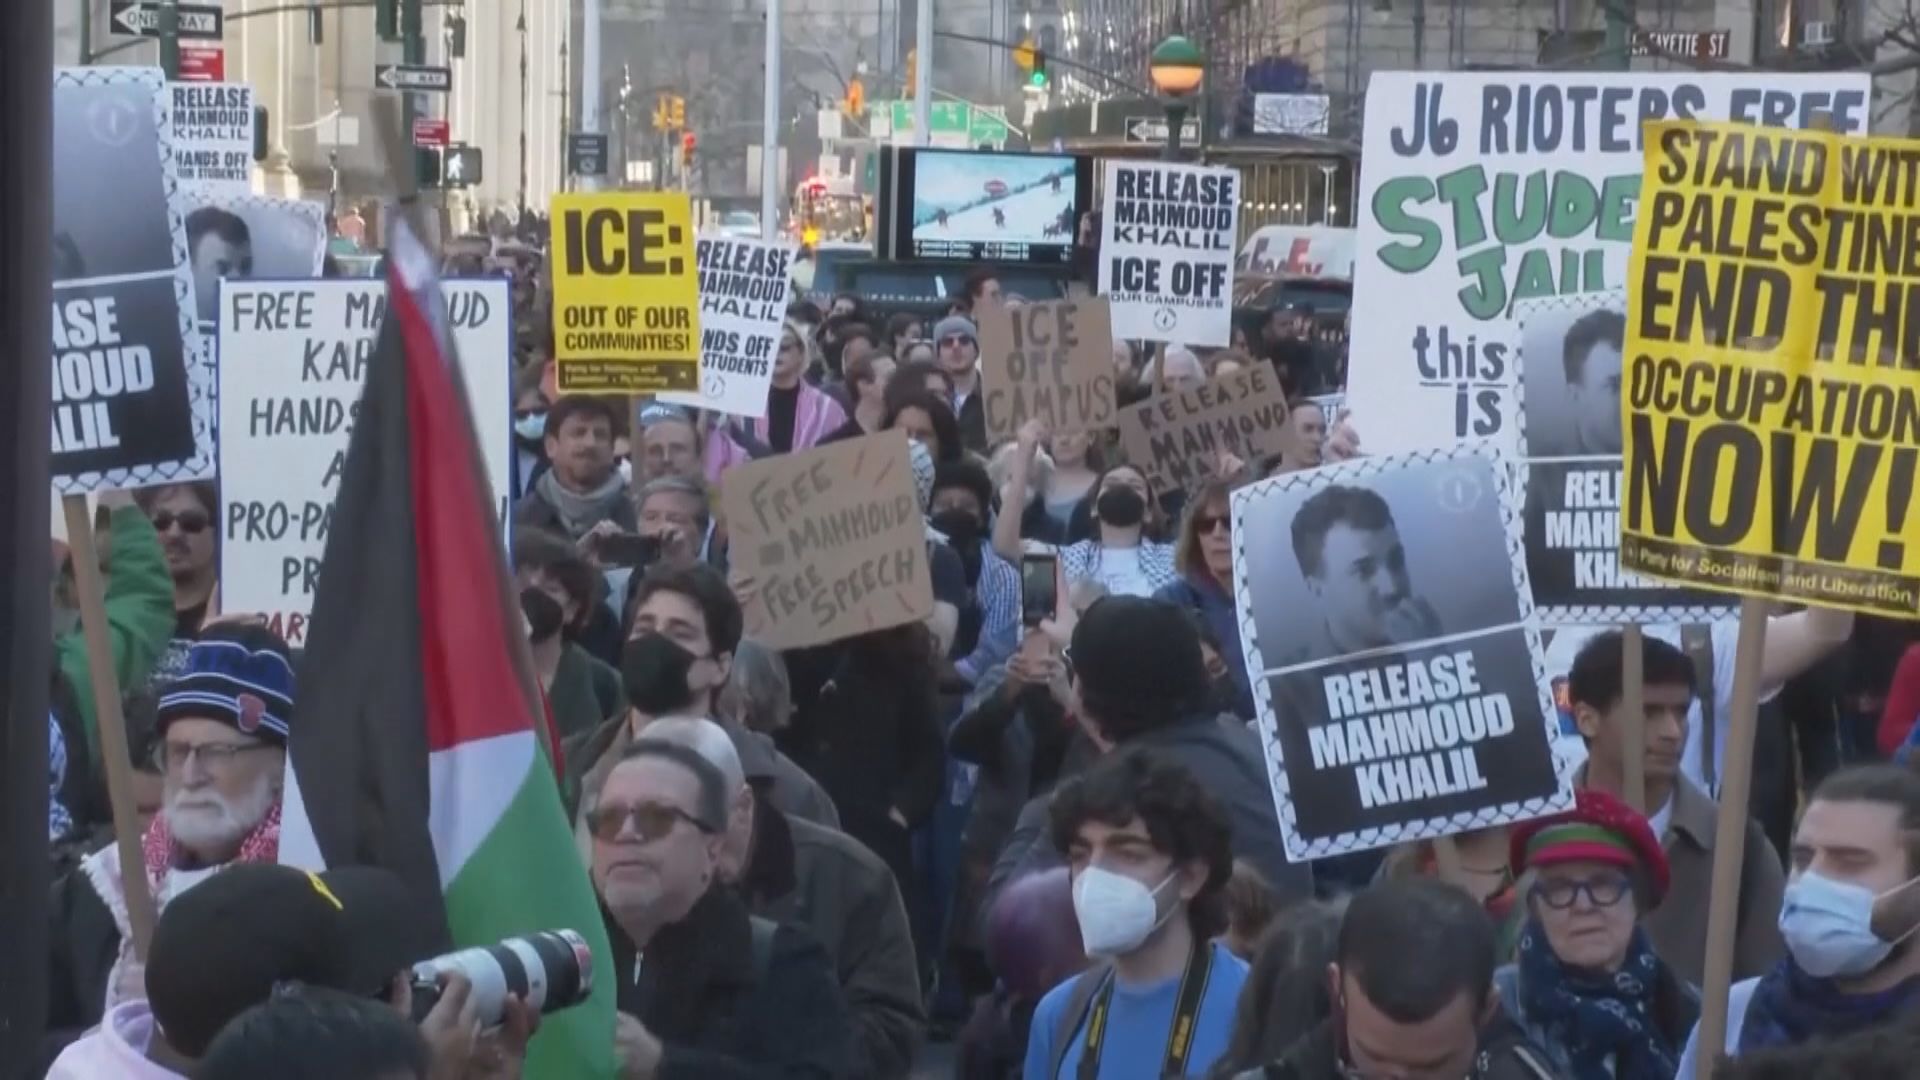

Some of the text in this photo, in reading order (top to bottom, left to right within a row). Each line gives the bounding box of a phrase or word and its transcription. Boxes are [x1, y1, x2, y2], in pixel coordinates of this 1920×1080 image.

[1708, 33, 1725, 56] ST
[173, 88, 250, 108] RELEASE
[173, 110, 249, 126] MAHMOUD
[1391, 82, 1459, 157] J6
[173, 128, 249, 140] KHALIL
[176, 151, 248, 168] HANDS OFF
[1658, 128, 1828, 197] STAND
[1117, 168, 1233, 205] RELEASE
[1114, 226, 1230, 250] KHALIL
[1115, 202, 1232, 231] MAHMOUD
[565, 208, 684, 275] ICE:
[696, 240, 790, 278] RELEASE
[1111, 256, 1227, 298] ICE OFF
[233, 290, 490, 331] FREE MAUD
[565, 306, 690, 329] OUT OF OUR
[702, 296, 779, 321] HALIL
[1145, 294, 1224, 309] CAMPUSES
[1640, 255, 1792, 352] END
[565, 332, 690, 351] COMMUNITIES!
[745, 335, 774, 358] OFF
[1012, 304, 1078, 348] ICE
[53, 345, 154, 401] OUD
[702, 353, 769, 376] STUDENTS
[1006, 350, 1069, 386] OFF
[1412, 325, 1507, 382] this
[986, 375, 1112, 433] CAMPUS
[1138, 369, 1266, 430] RELEASE
[1456, 382, 1502, 437] is
[53, 402, 120, 453] LIL
[751, 457, 832, 534] FREE
[1628, 412, 1918, 571] NOW!
[788, 494, 912, 560] MAHMOUD
[762, 564, 823, 623] FREE
[811, 547, 914, 629] SPEECH
[1697, 557, 1780, 584] Socialism
[1783, 574, 1816, 589] and
[1821, 576, 1912, 603] Liberation
[1323, 650, 1480, 719] RELEASE
[1308, 694, 1515, 769] MAHMOUD
[1355, 747, 1488, 808] KHALIL
